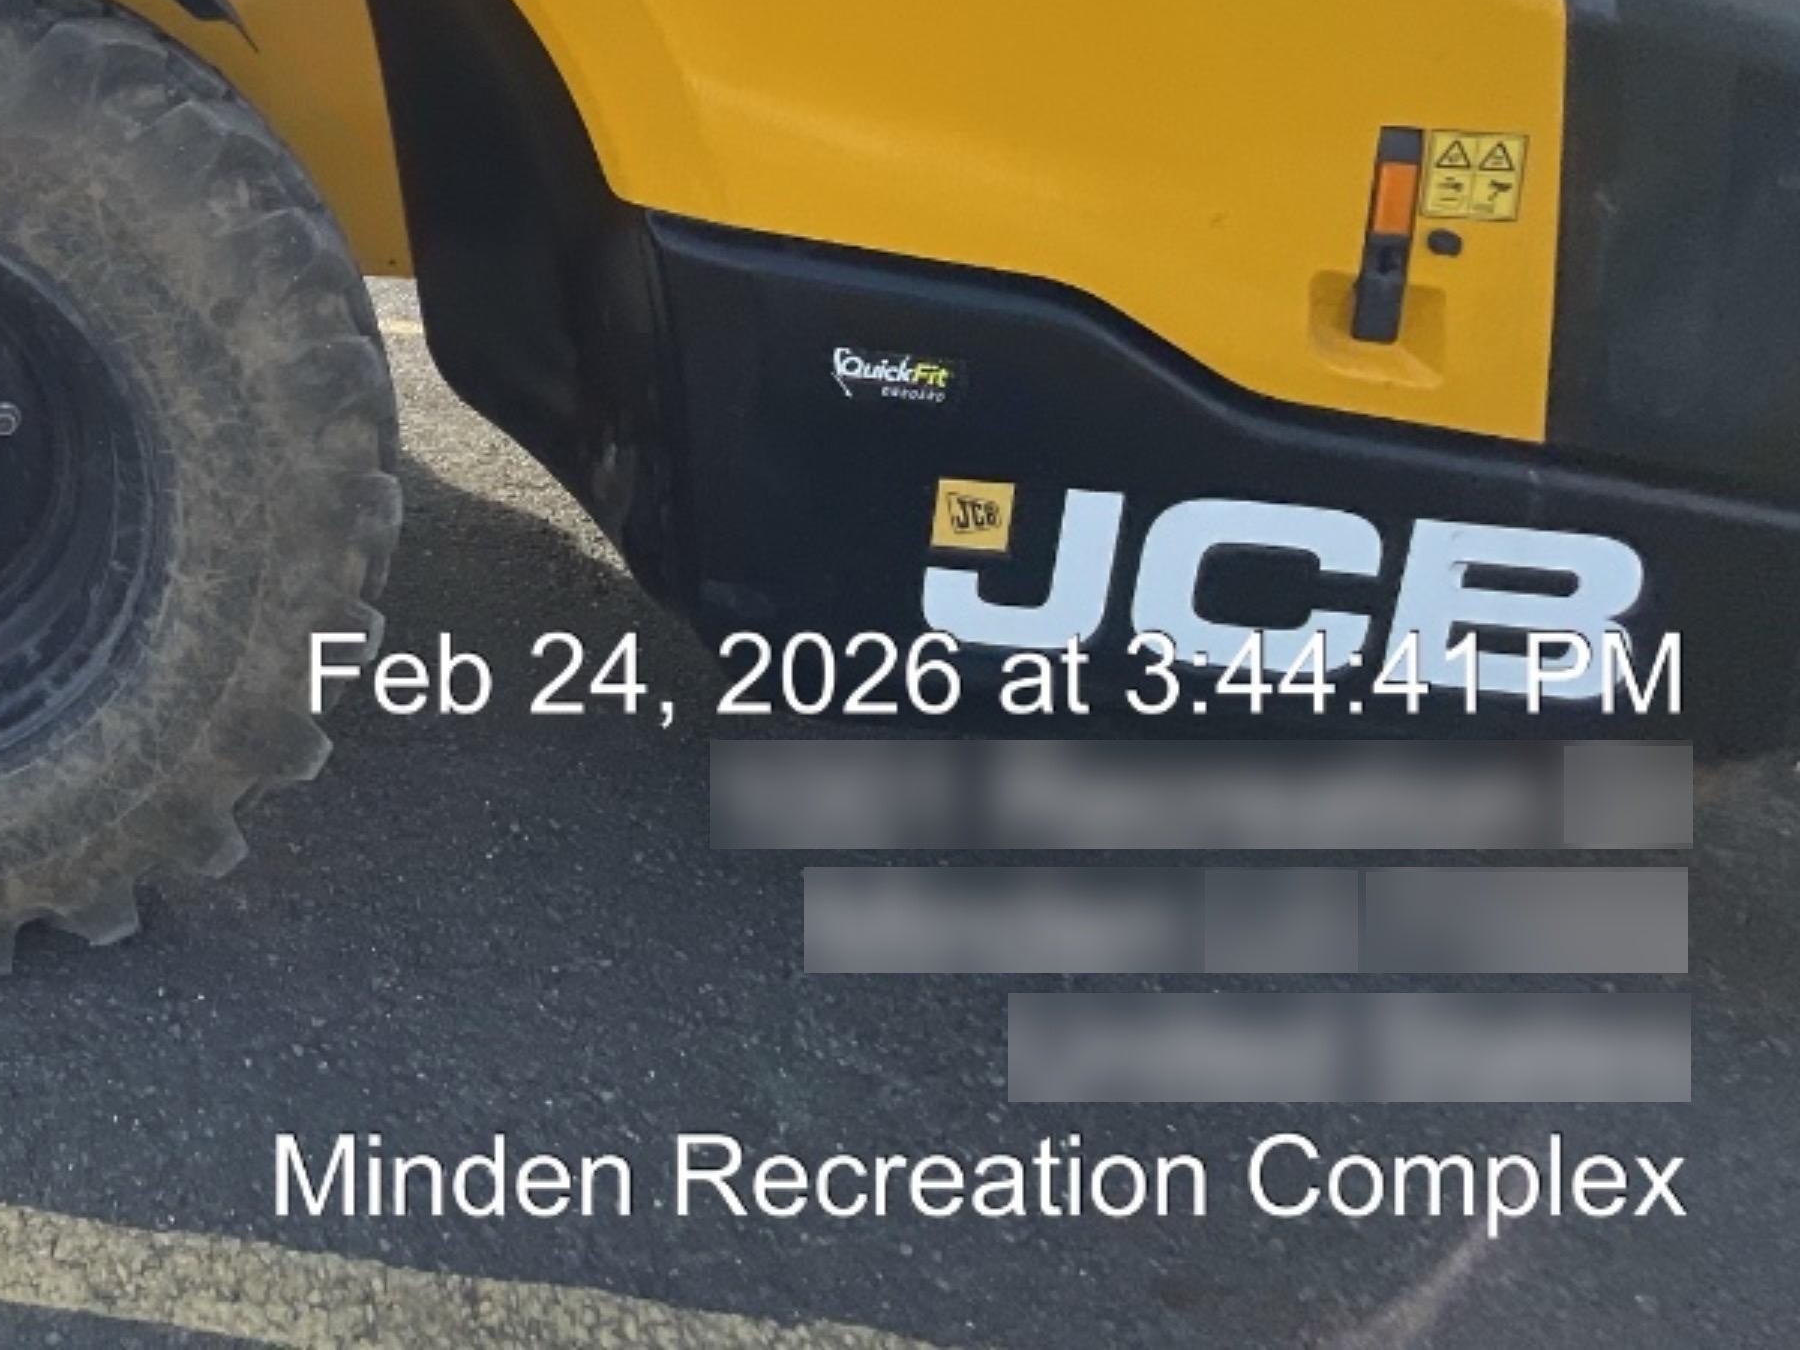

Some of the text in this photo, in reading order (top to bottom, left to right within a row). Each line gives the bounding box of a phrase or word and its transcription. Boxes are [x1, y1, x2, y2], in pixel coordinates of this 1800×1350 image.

[834, 348, 949, 388] QuickFit
[956, 497, 1000, 528] JCB
[922, 488, 1645, 700] JCB
